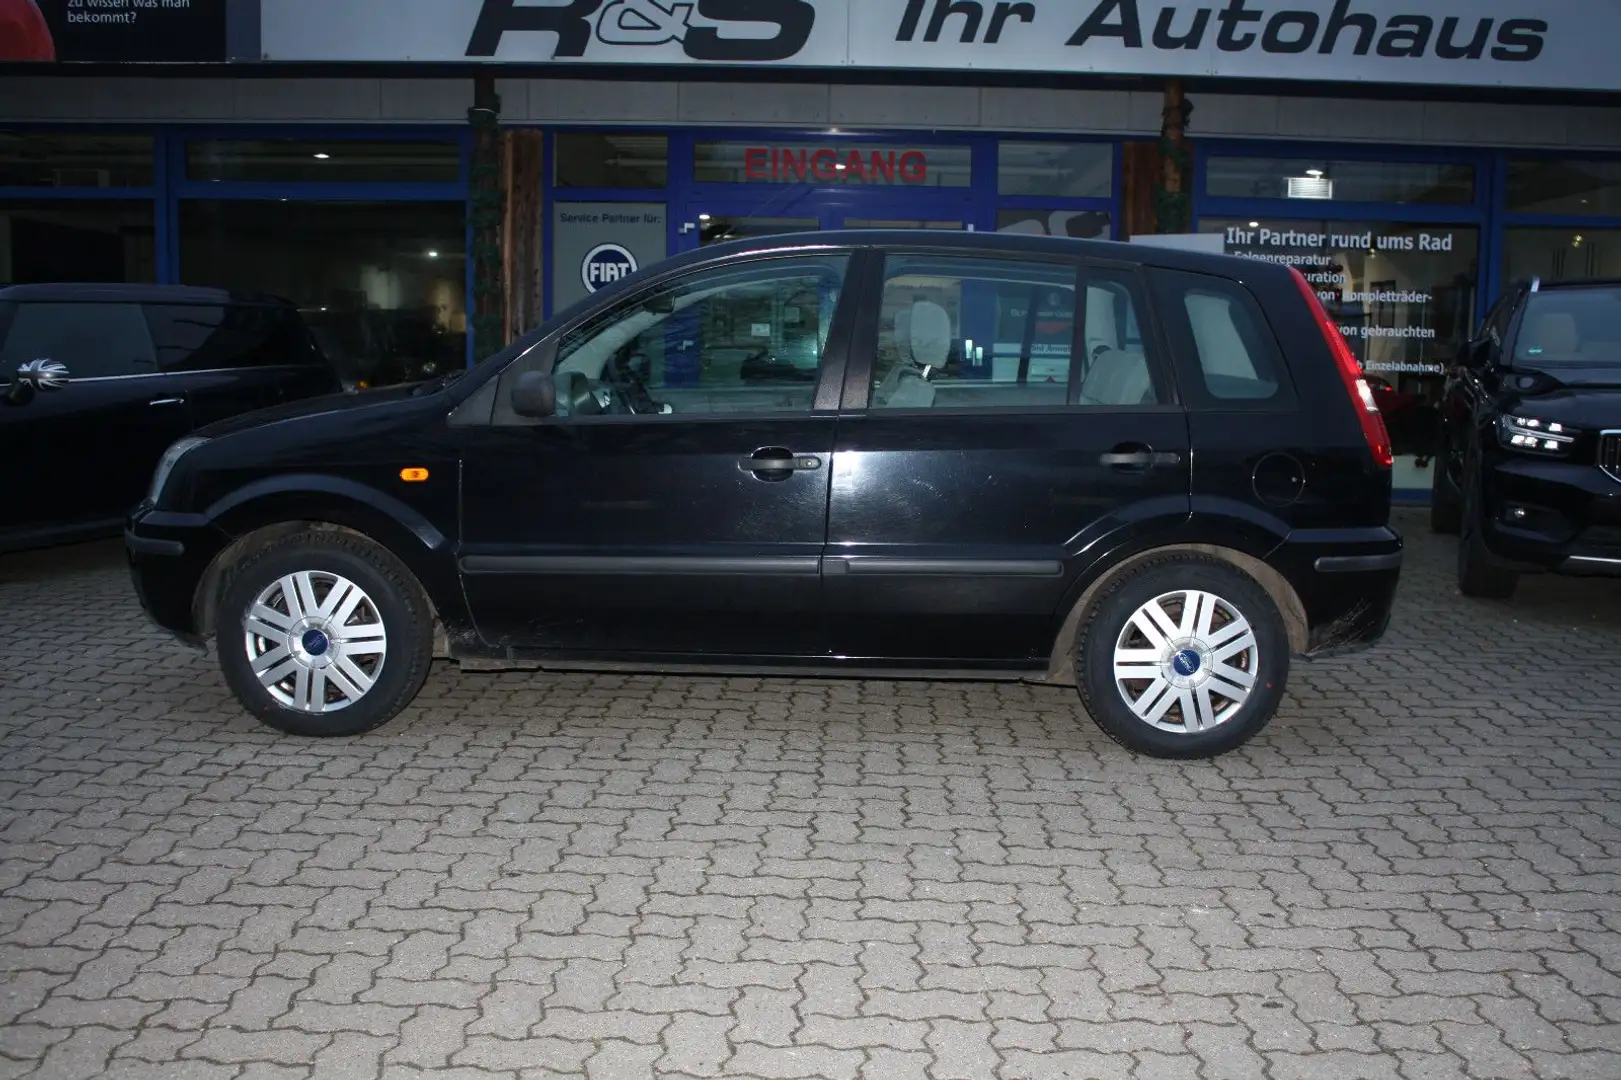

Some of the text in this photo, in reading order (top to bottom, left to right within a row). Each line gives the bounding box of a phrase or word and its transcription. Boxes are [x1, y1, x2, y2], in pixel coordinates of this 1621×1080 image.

[67, 0, 190, 8] zu wissen was man
[67, 10, 137, 24] bekommt?
[895, 0, 1036, 44] Ihr
[1065, 0, 1549, 62] Autohaus
[744, 147, 927, 182] EINGANG
[560, 212, 661, 224] Service Partner für:
[1226, 227, 1453, 251] Ihr Partner rund ums Rad
[589, 262, 630, 283] FIAT
[1360, 324, 1436, 339] gebrauchten
[1365, 359, 1445, 374] Einzelabnahme)
